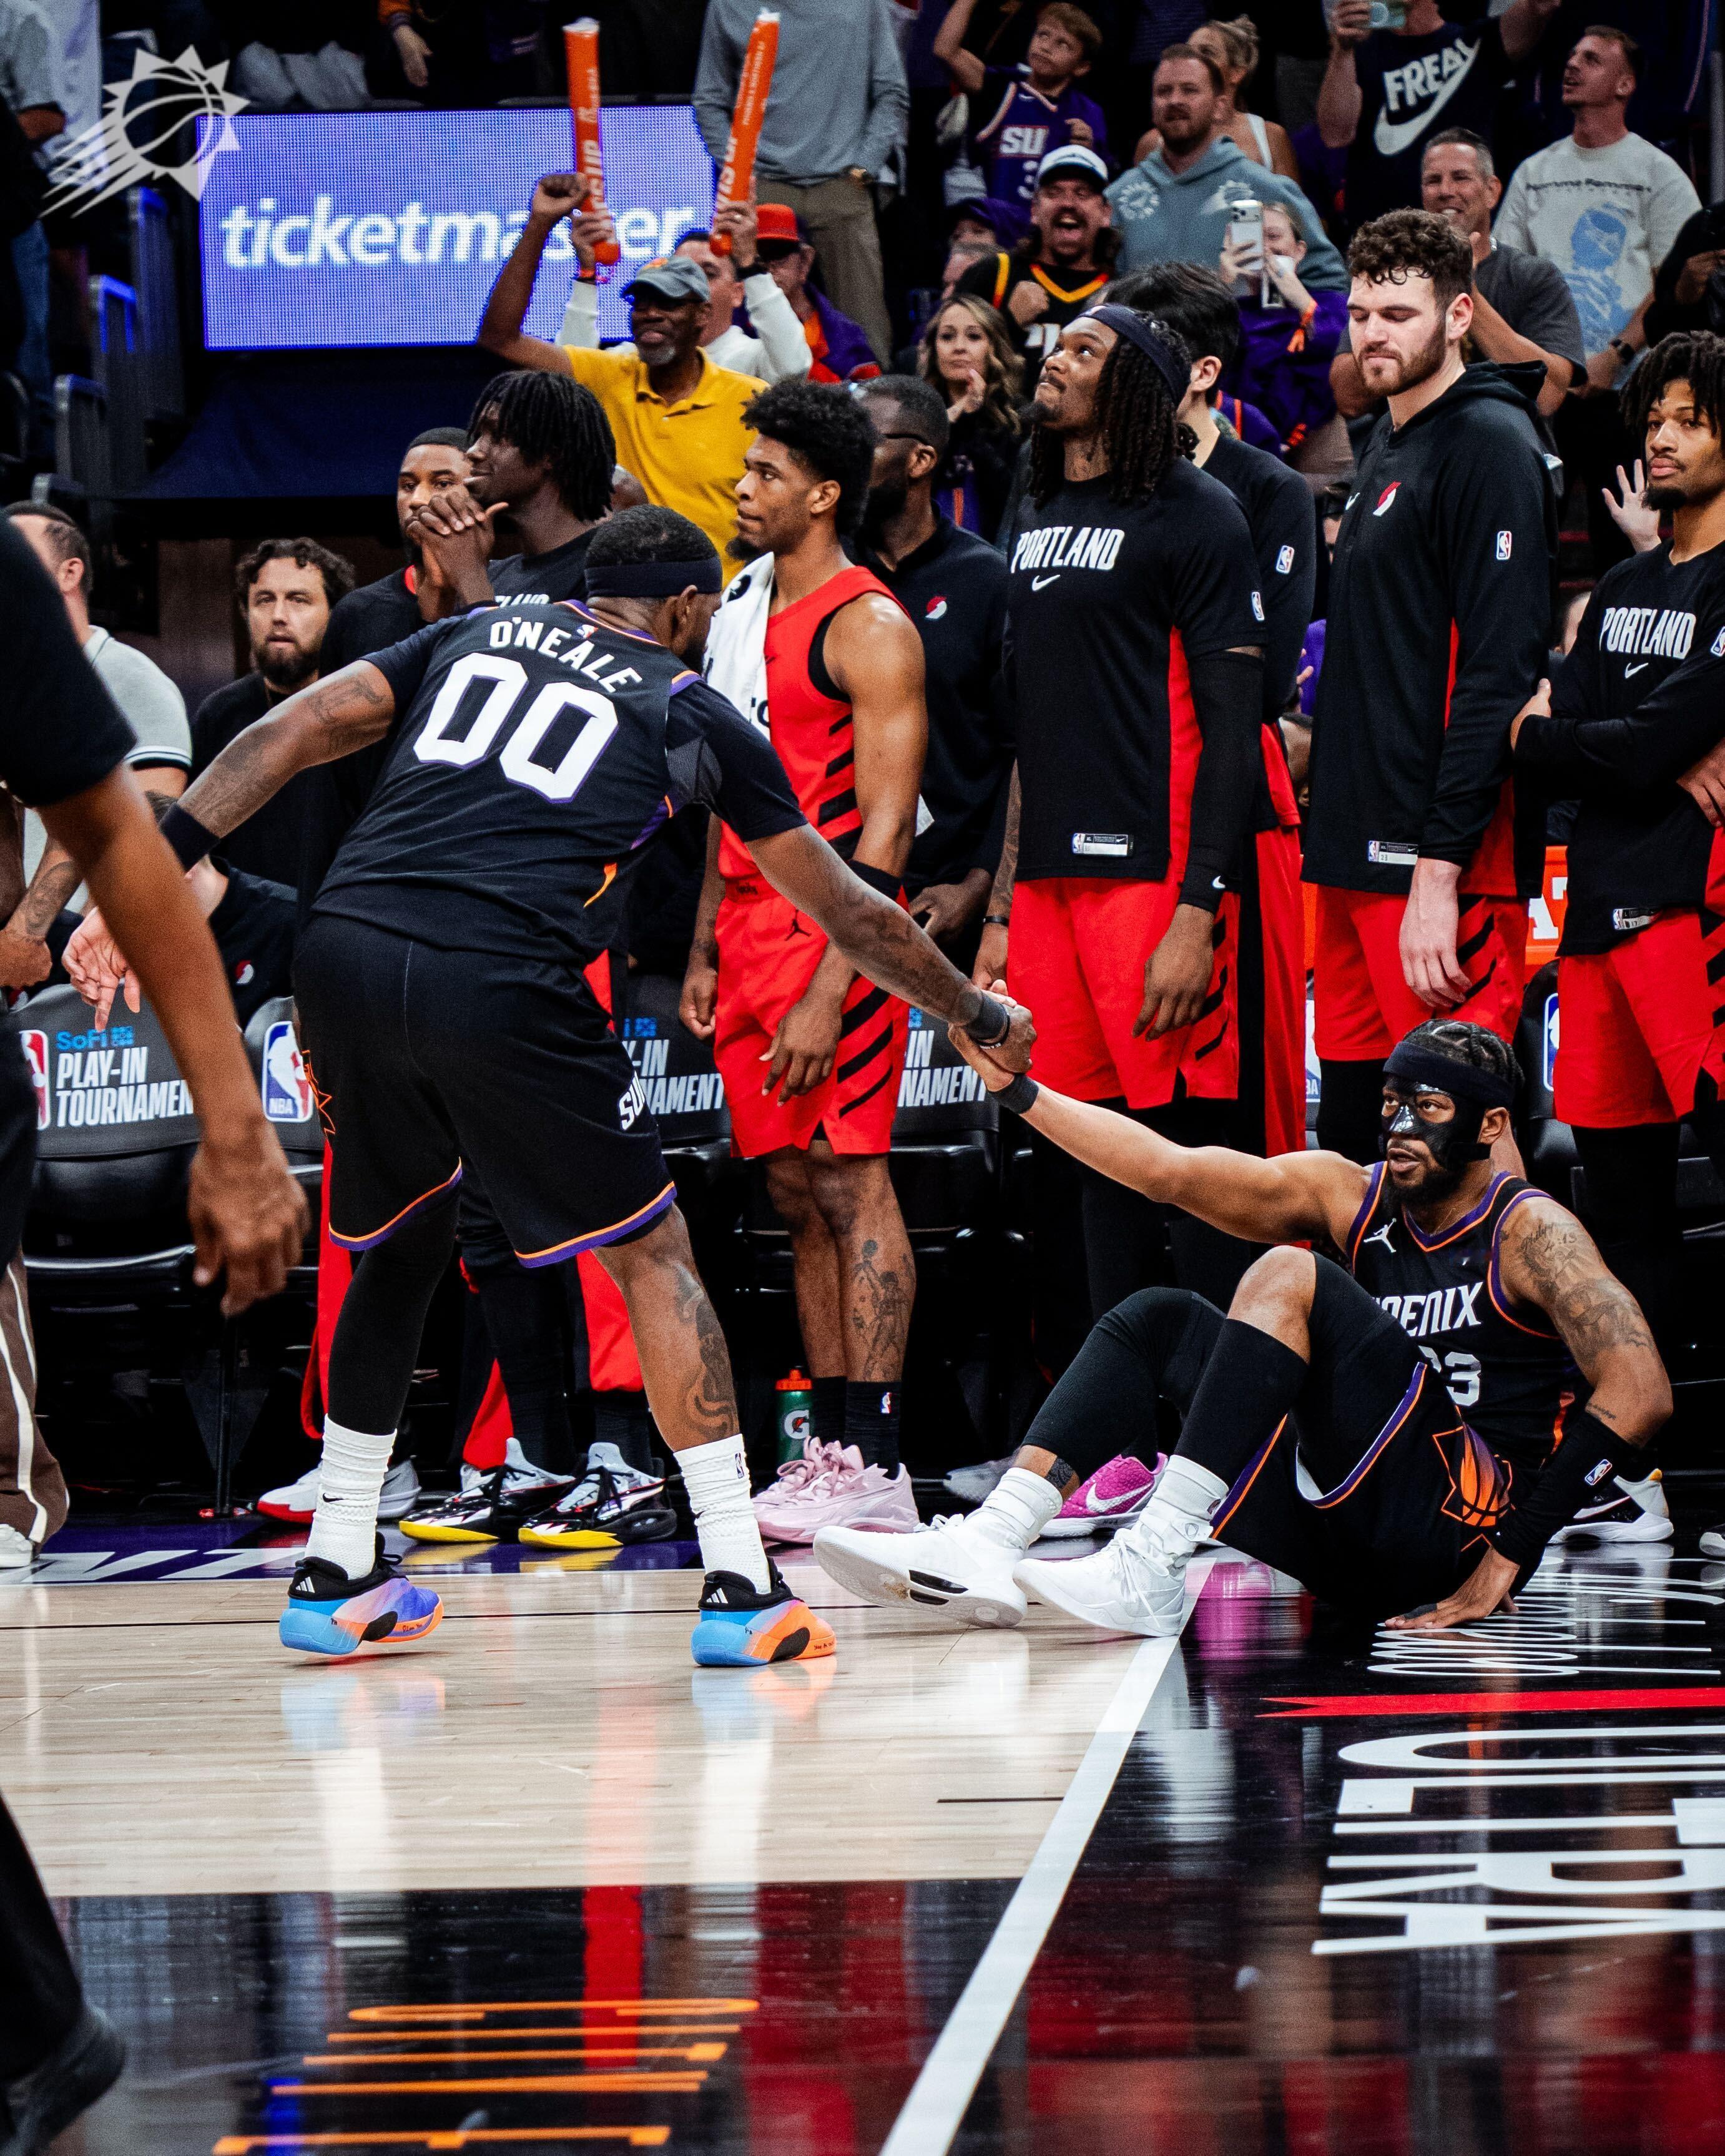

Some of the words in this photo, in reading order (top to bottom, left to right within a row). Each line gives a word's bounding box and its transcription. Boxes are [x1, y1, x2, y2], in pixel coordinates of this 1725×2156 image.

[1011, 526, 1125, 574] PORTLAND
[489, 617, 643, 693] O'NEALE
[1599, 607, 1697, 660] PORTLAND
[412, 652, 619, 804] 00
[56, 1026, 107, 1051] SoFi
[56, 1046, 149, 1089] PLAY-IN
[1418, 1345, 1482, 1407] 3
